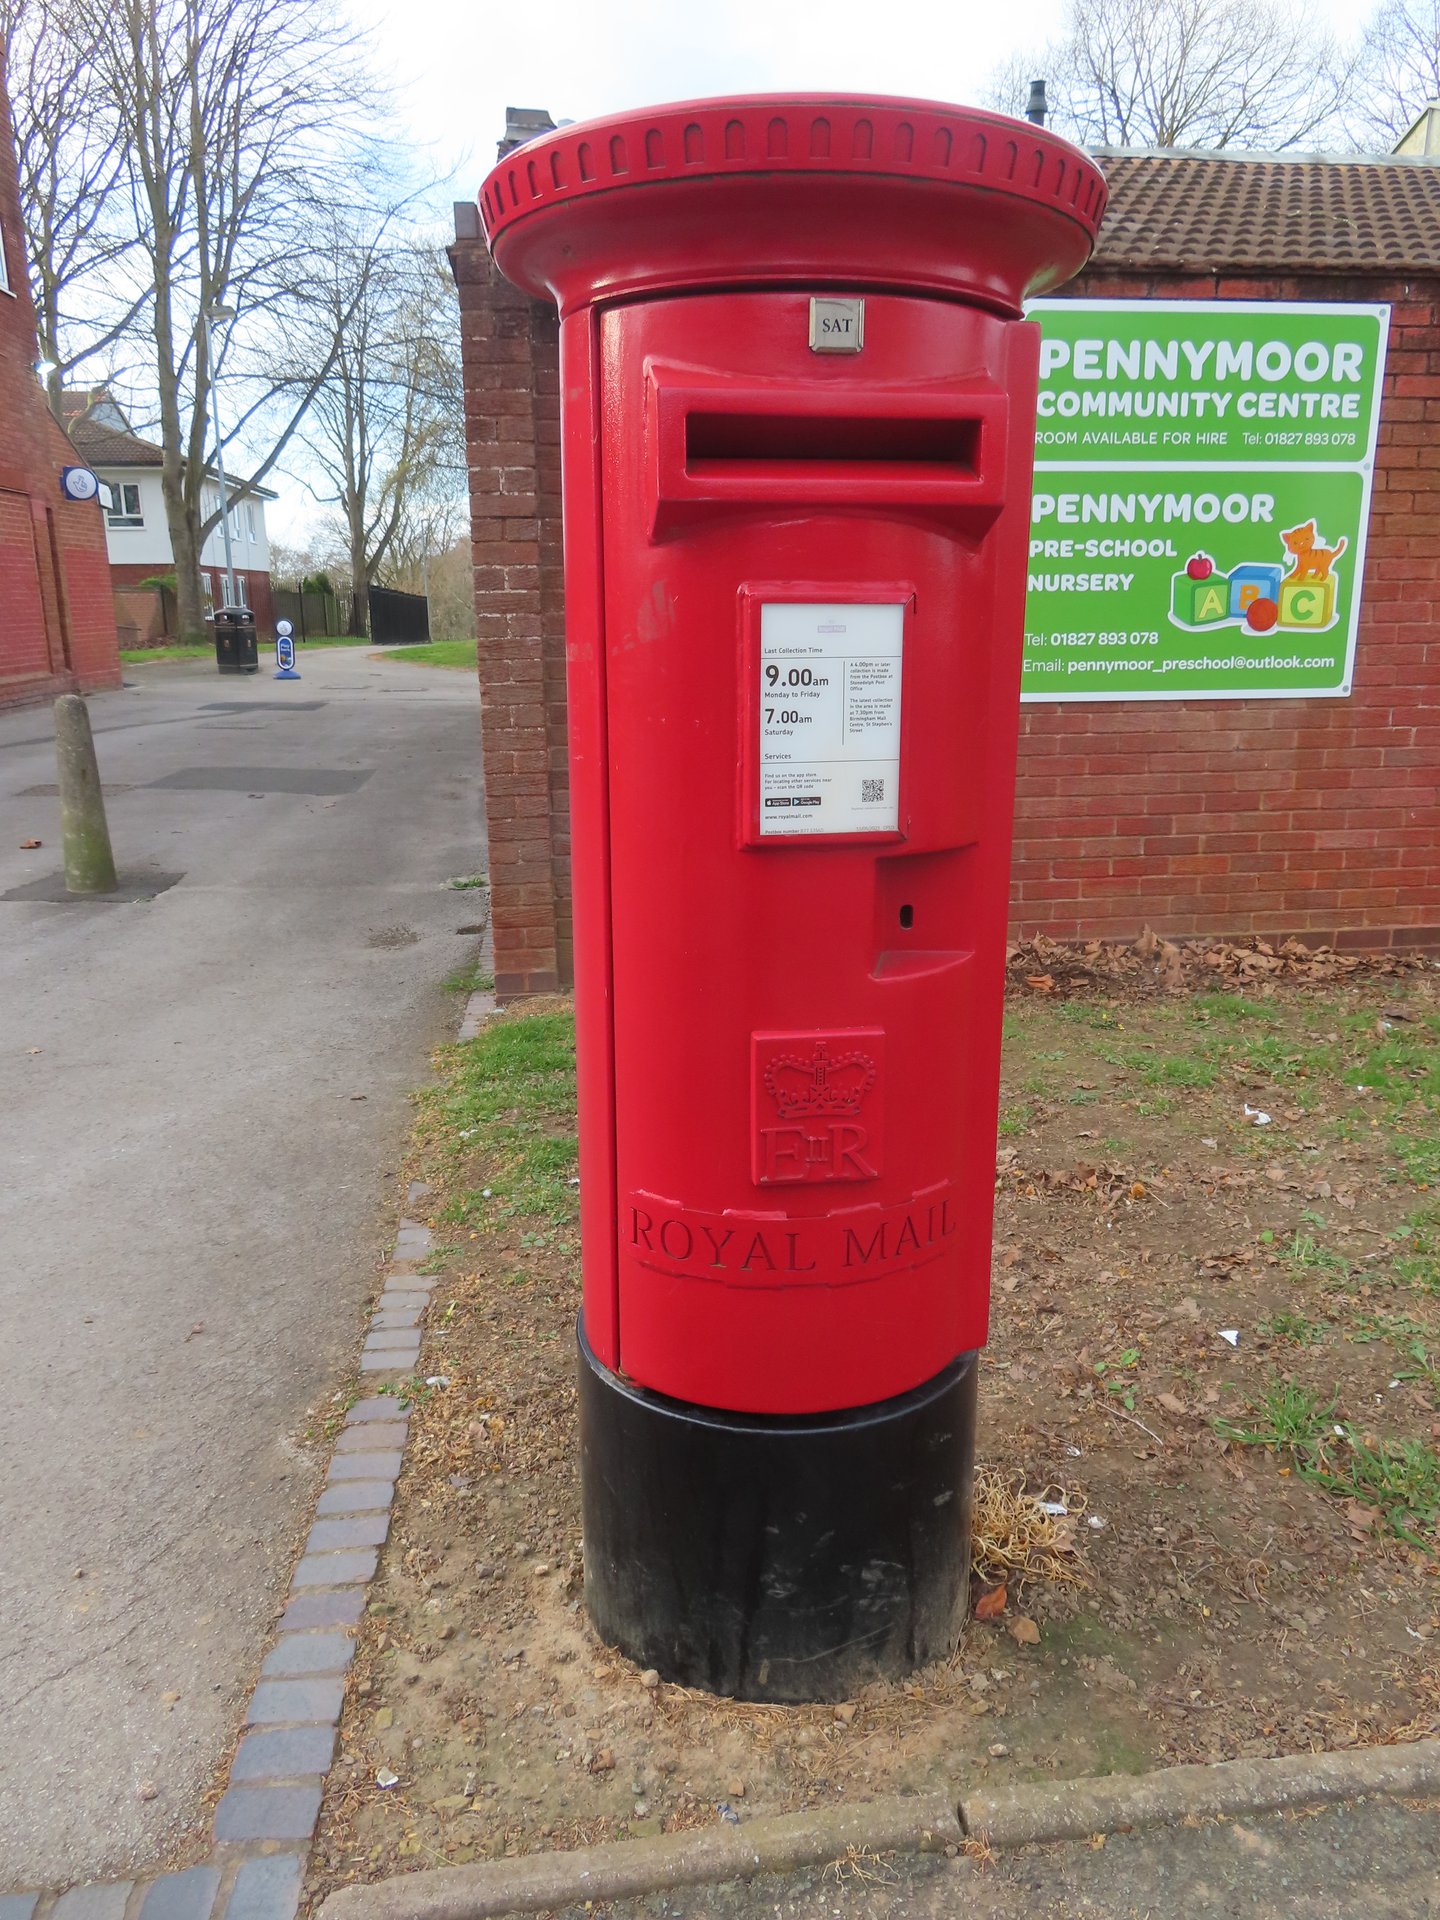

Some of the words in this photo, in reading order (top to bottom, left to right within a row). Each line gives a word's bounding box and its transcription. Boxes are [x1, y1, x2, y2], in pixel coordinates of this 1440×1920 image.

[822, 318, 853, 333] SAT
[1038, 339, 1363, 382] PENNYMOOR
[1036, 390, 1233, 417] COMMUNITY
[1236, 392, 1361, 419] CENTRE
[1034, 431, 1077, 445] ROOM
[1081, 431, 1157, 445] AVAILABLE
[1162, 431, 1191, 445] FOR
[1196, 431, 1227, 445] HIRE
[1242, 432, 1262, 445] Tel:
[1264, 432, 1303, 445] 01827
[1304, 432, 1329, 446] 893
[1331, 432, 1356, 446] 078
[1031, 493, 1275, 524] PENNYMOOR
[1028, 539, 1178, 558] PRE-SCHOOL
[1027, 573, 1135, 592] NURSERY
[1198, 588, 1224, 618] A
[1290, 590, 1316, 621] C
[1024, 633, 1047, 646] Tel:
[1050, 633, 1095, 646] 01827
[1098, 633, 1126, 645] 893
[1130, 632, 1159, 645] 078
[1023, 659, 1065, 672] Email:
[1067, 656, 1335, 674] pennymoor_preschool@outlook.com
[765, 664, 829, 687] 9.00am
[764, 692, 790, 700] Monday
[800, 690, 820, 699] Friday
[764, 708, 812, 724] 7.00am
[764, 728, 794, 736] Saturday
[764, 752, 791, 760] Services
[629, 1205, 817, 1272] ROYAL
[841, 1198, 957, 1268] MAIL
